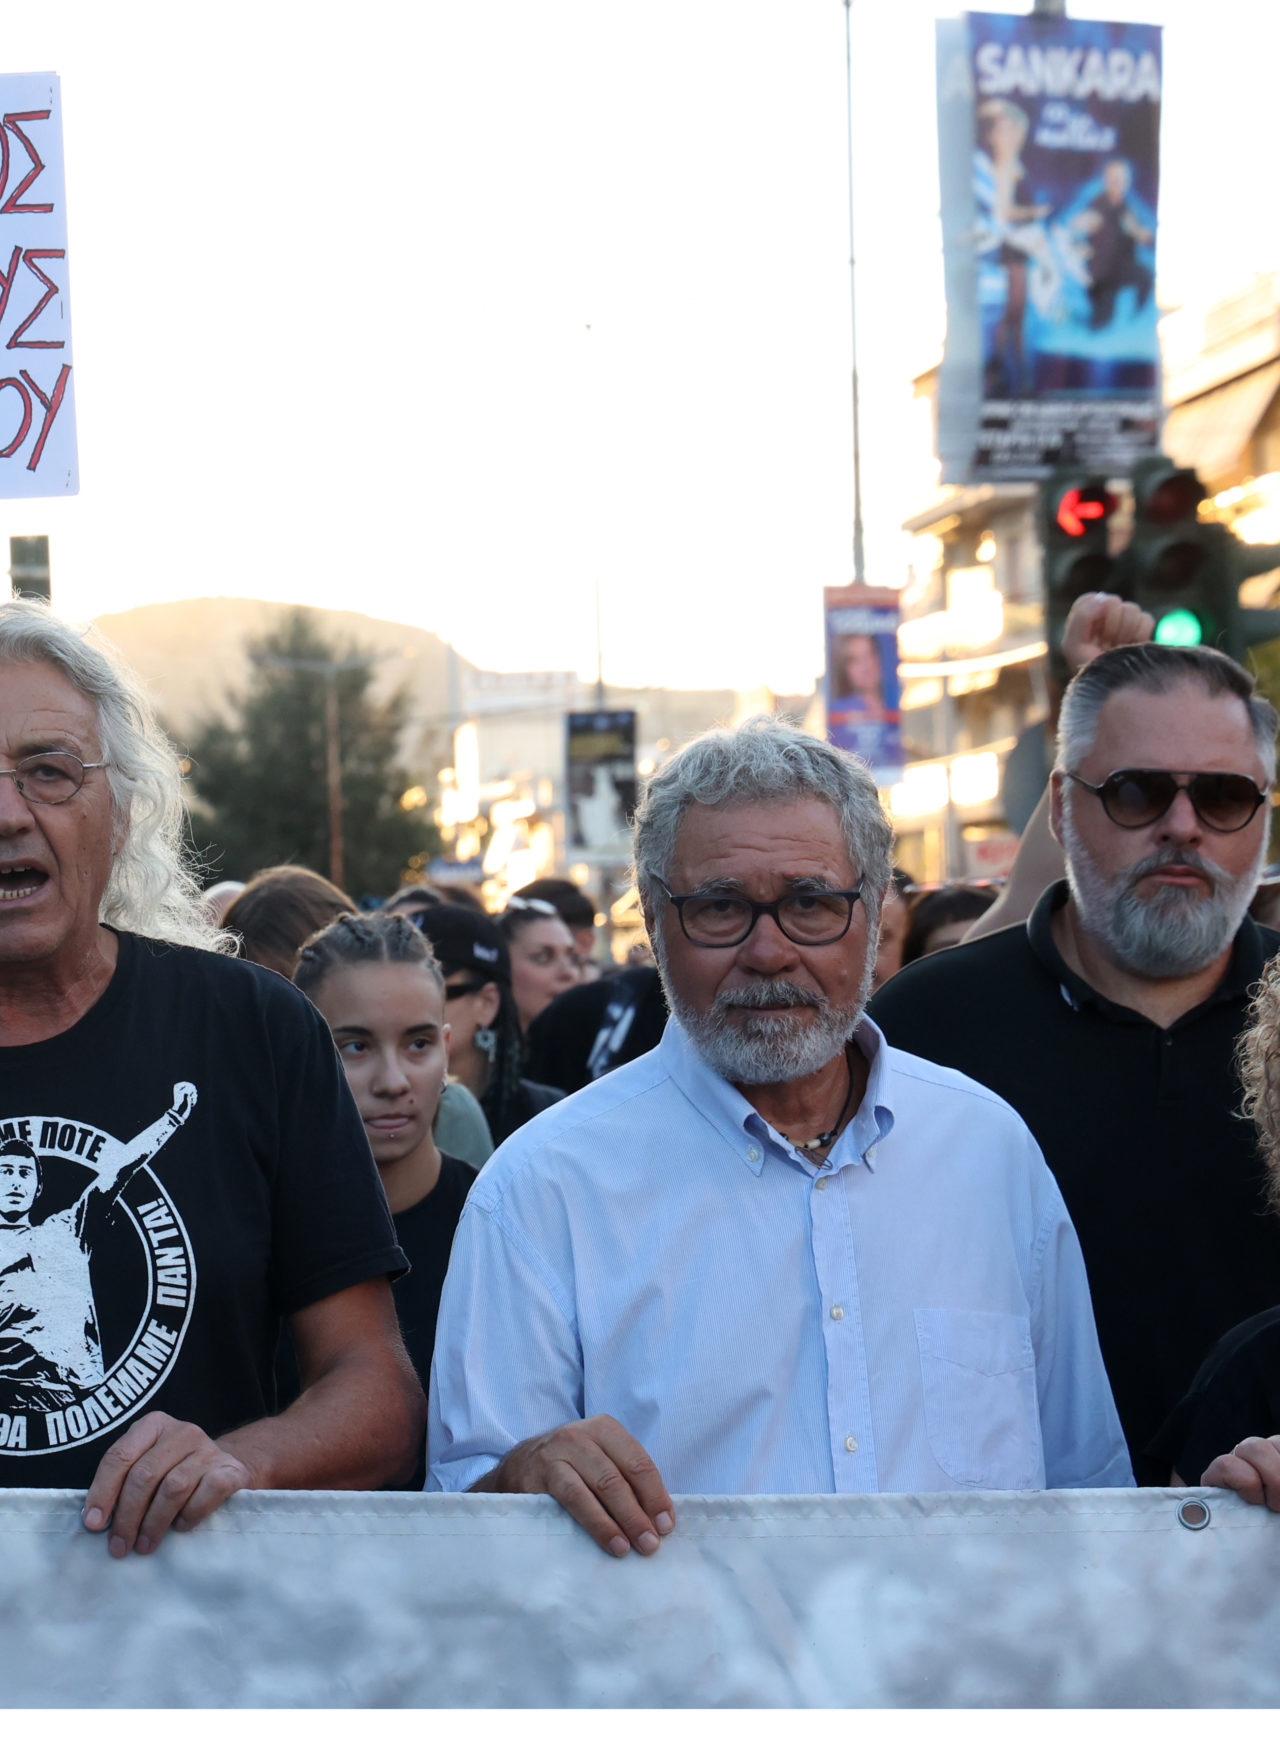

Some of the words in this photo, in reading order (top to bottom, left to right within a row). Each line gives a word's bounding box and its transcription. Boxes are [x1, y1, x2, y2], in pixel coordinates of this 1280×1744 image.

[976, 43, 1160, 102] SANKARA
[39, 1120, 107, 1163] ΠΟΤΕ
[45, 1318, 178, 1446] ΠΟΛΕΜΑΜΕ
[136, 1197, 188, 1308] ΠΑΝΤΑ!
